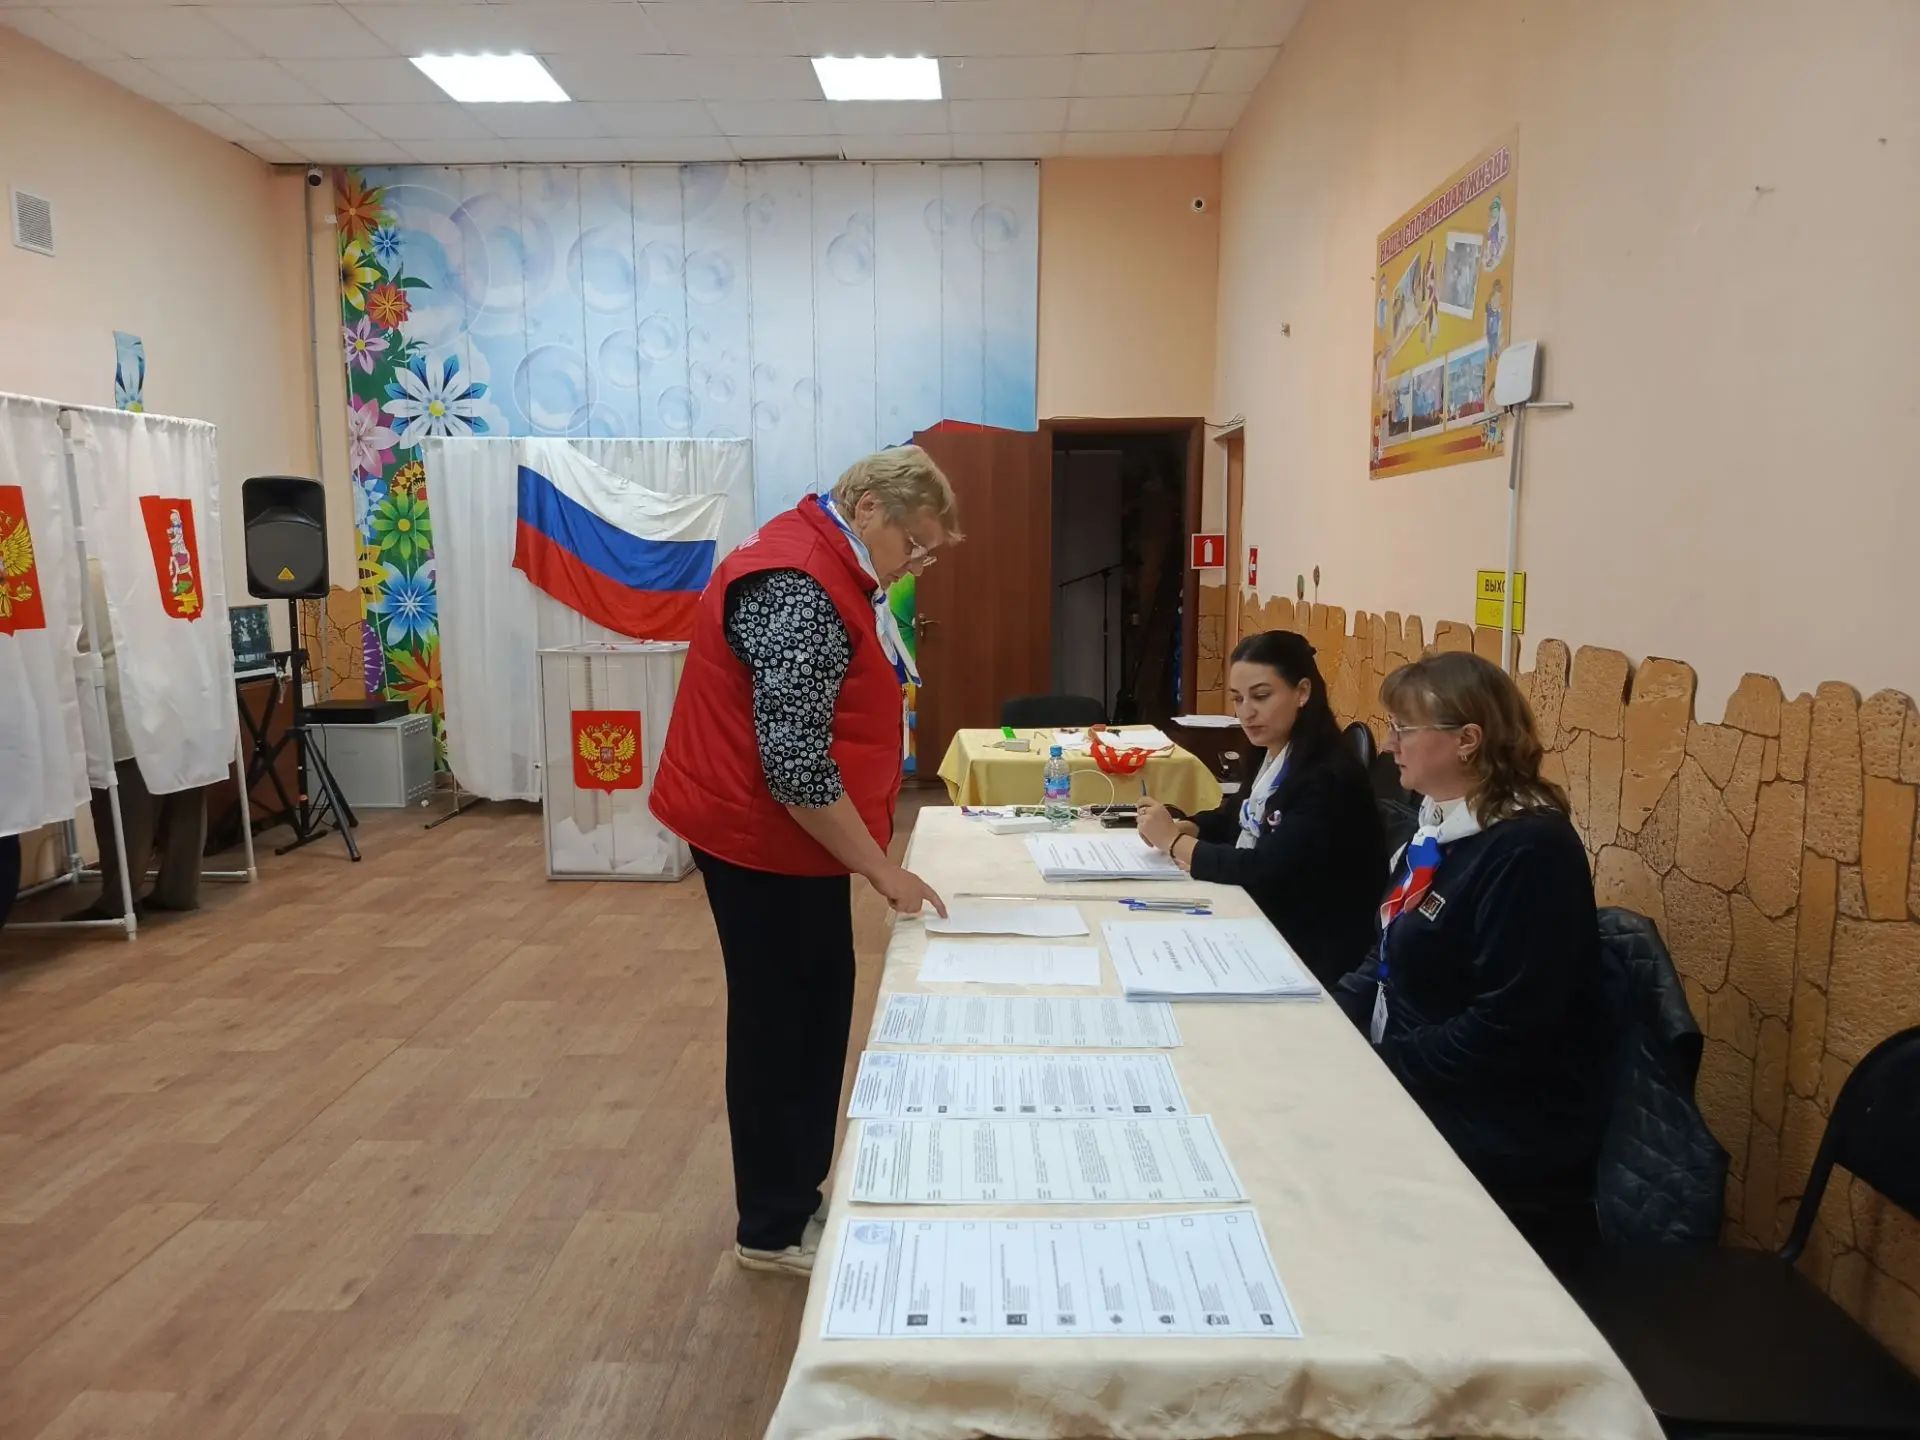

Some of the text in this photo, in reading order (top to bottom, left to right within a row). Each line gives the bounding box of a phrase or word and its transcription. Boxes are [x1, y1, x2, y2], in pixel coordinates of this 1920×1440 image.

[1380, 147, 1509, 266] НАША СПОРТИВНАЯ ЖИЗНЬ
[1484, 579, 1505, 593] ВЫХО
